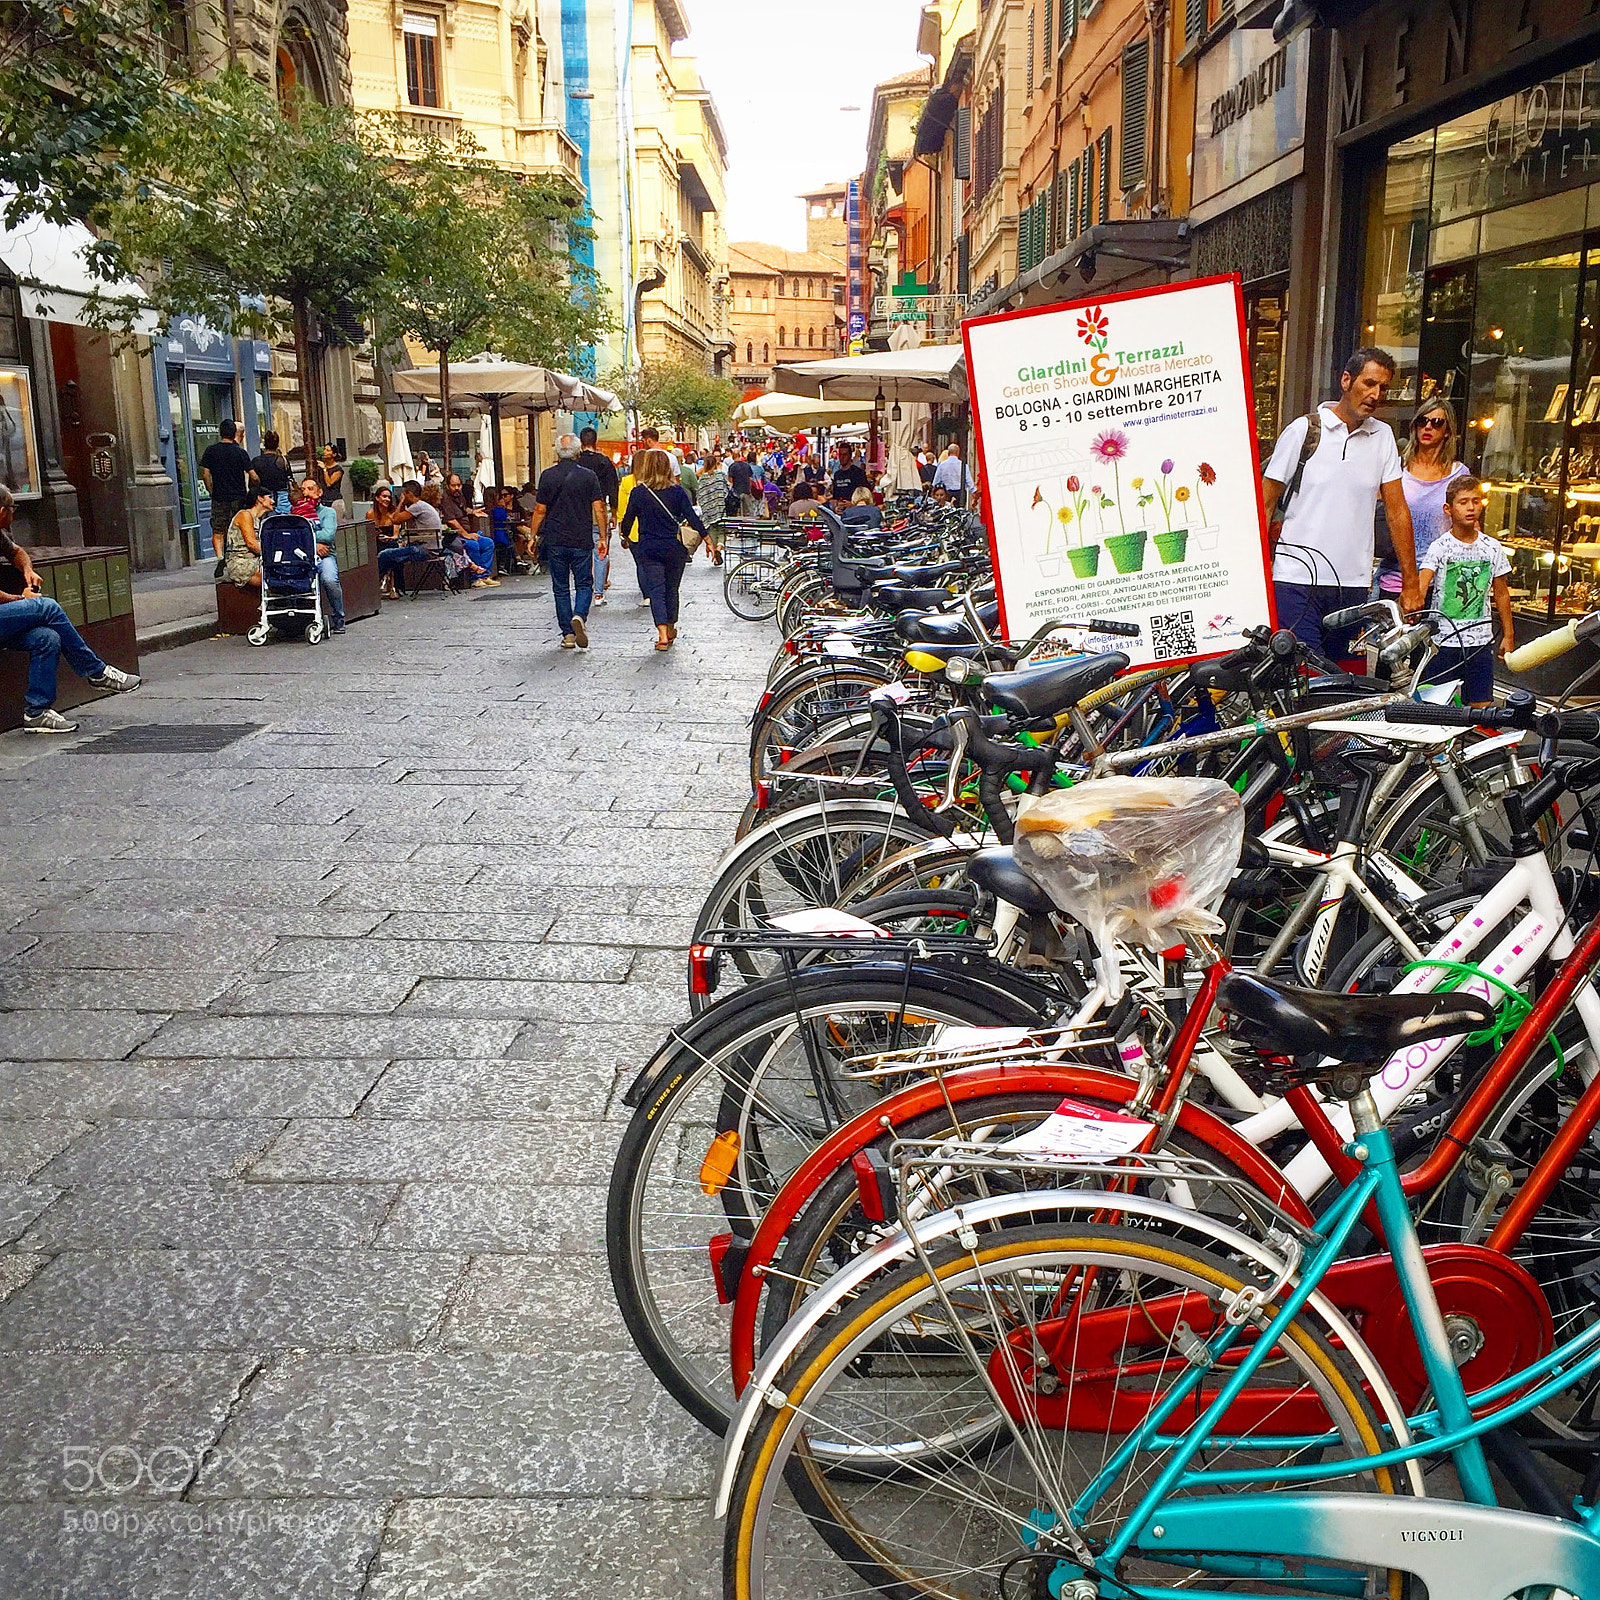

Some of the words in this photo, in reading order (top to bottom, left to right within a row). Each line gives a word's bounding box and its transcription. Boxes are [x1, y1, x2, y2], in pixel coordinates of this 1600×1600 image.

[1002, 381, 1049, 398] Garden
[1053, 376, 1088, 389] Show
[1120, 363, 1160, 378] Mostra
[1164, 354, 1213, 371] Mercato
[1018, 357, 1087, 382] Giardini
[1089, 353, 1119, 386] &
[1115, 341, 1185, 365] Terrazzi
[995, 397, 1061, 419] BOLOGNA
[1072, 385, 1130, 406] GIARDINI
[1133, 370, 1222, 396] MARGHERITA
[1019, 419, 1028, 431] 8
[1042, 416, 1050, 427] 9
[1066, 411, 1082, 423] 10
[1087, 399, 1163, 420] settembre
[1168, 390, 1202, 407] 2017
[1029, 605, 1069, 618] ARTISTICO
[1075, 602, 1100, 610] CORSI
[1105, 594, 1146, 606] CONVEGNI
[1160, 585, 1196, 597] INCONTRI
[1198, 579, 1229, 591] TECNICI
[1034, 583, 1086, 598] ESPOSIZIONE
[1097, 576, 1131, 588] GIARDINI
[1137, 570, 1170, 580] MOSTRA
[1171, 563, 1210, 575] MERCATO
[1211, 561, 1220, 569] DI
[1113, 579, 1171, 595] ANTIQUARIATO
[1086, 600, 1154, 617] AGROALIMENTARI
[1171, 591, 1212, 603] TERRITORI
[1400, 1529, 1464, 1543] VIGNOLI
